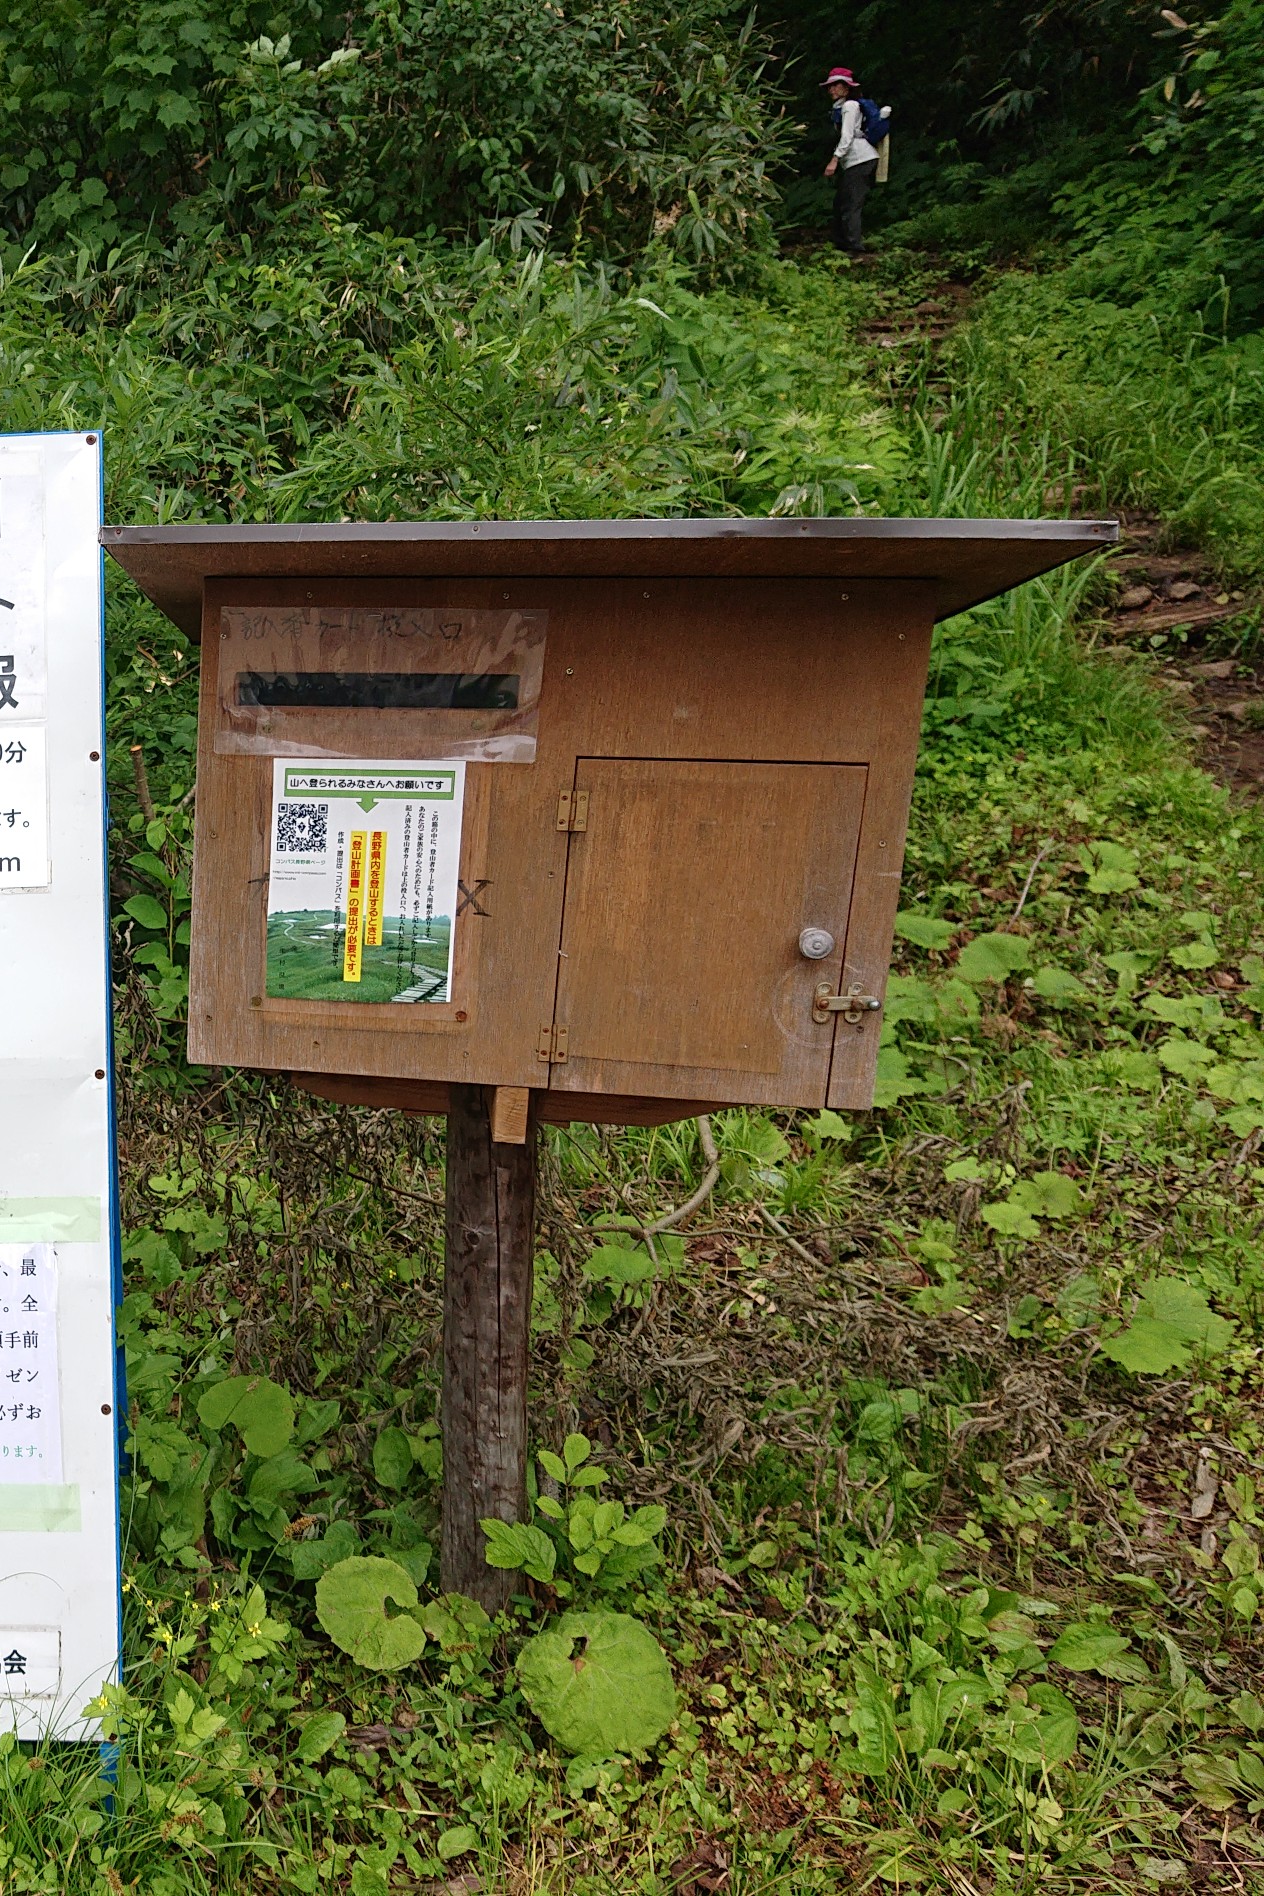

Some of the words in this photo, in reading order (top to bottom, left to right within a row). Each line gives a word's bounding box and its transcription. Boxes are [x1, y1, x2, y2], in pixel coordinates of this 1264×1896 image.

[290, 778, 444, 790] 山へ登られるみなさんへお願いです
[346, 835, 363, 976] 「登山計画書」の提出が必要です。
[367, 832, 382, 945] 長野県内を登山するときは
